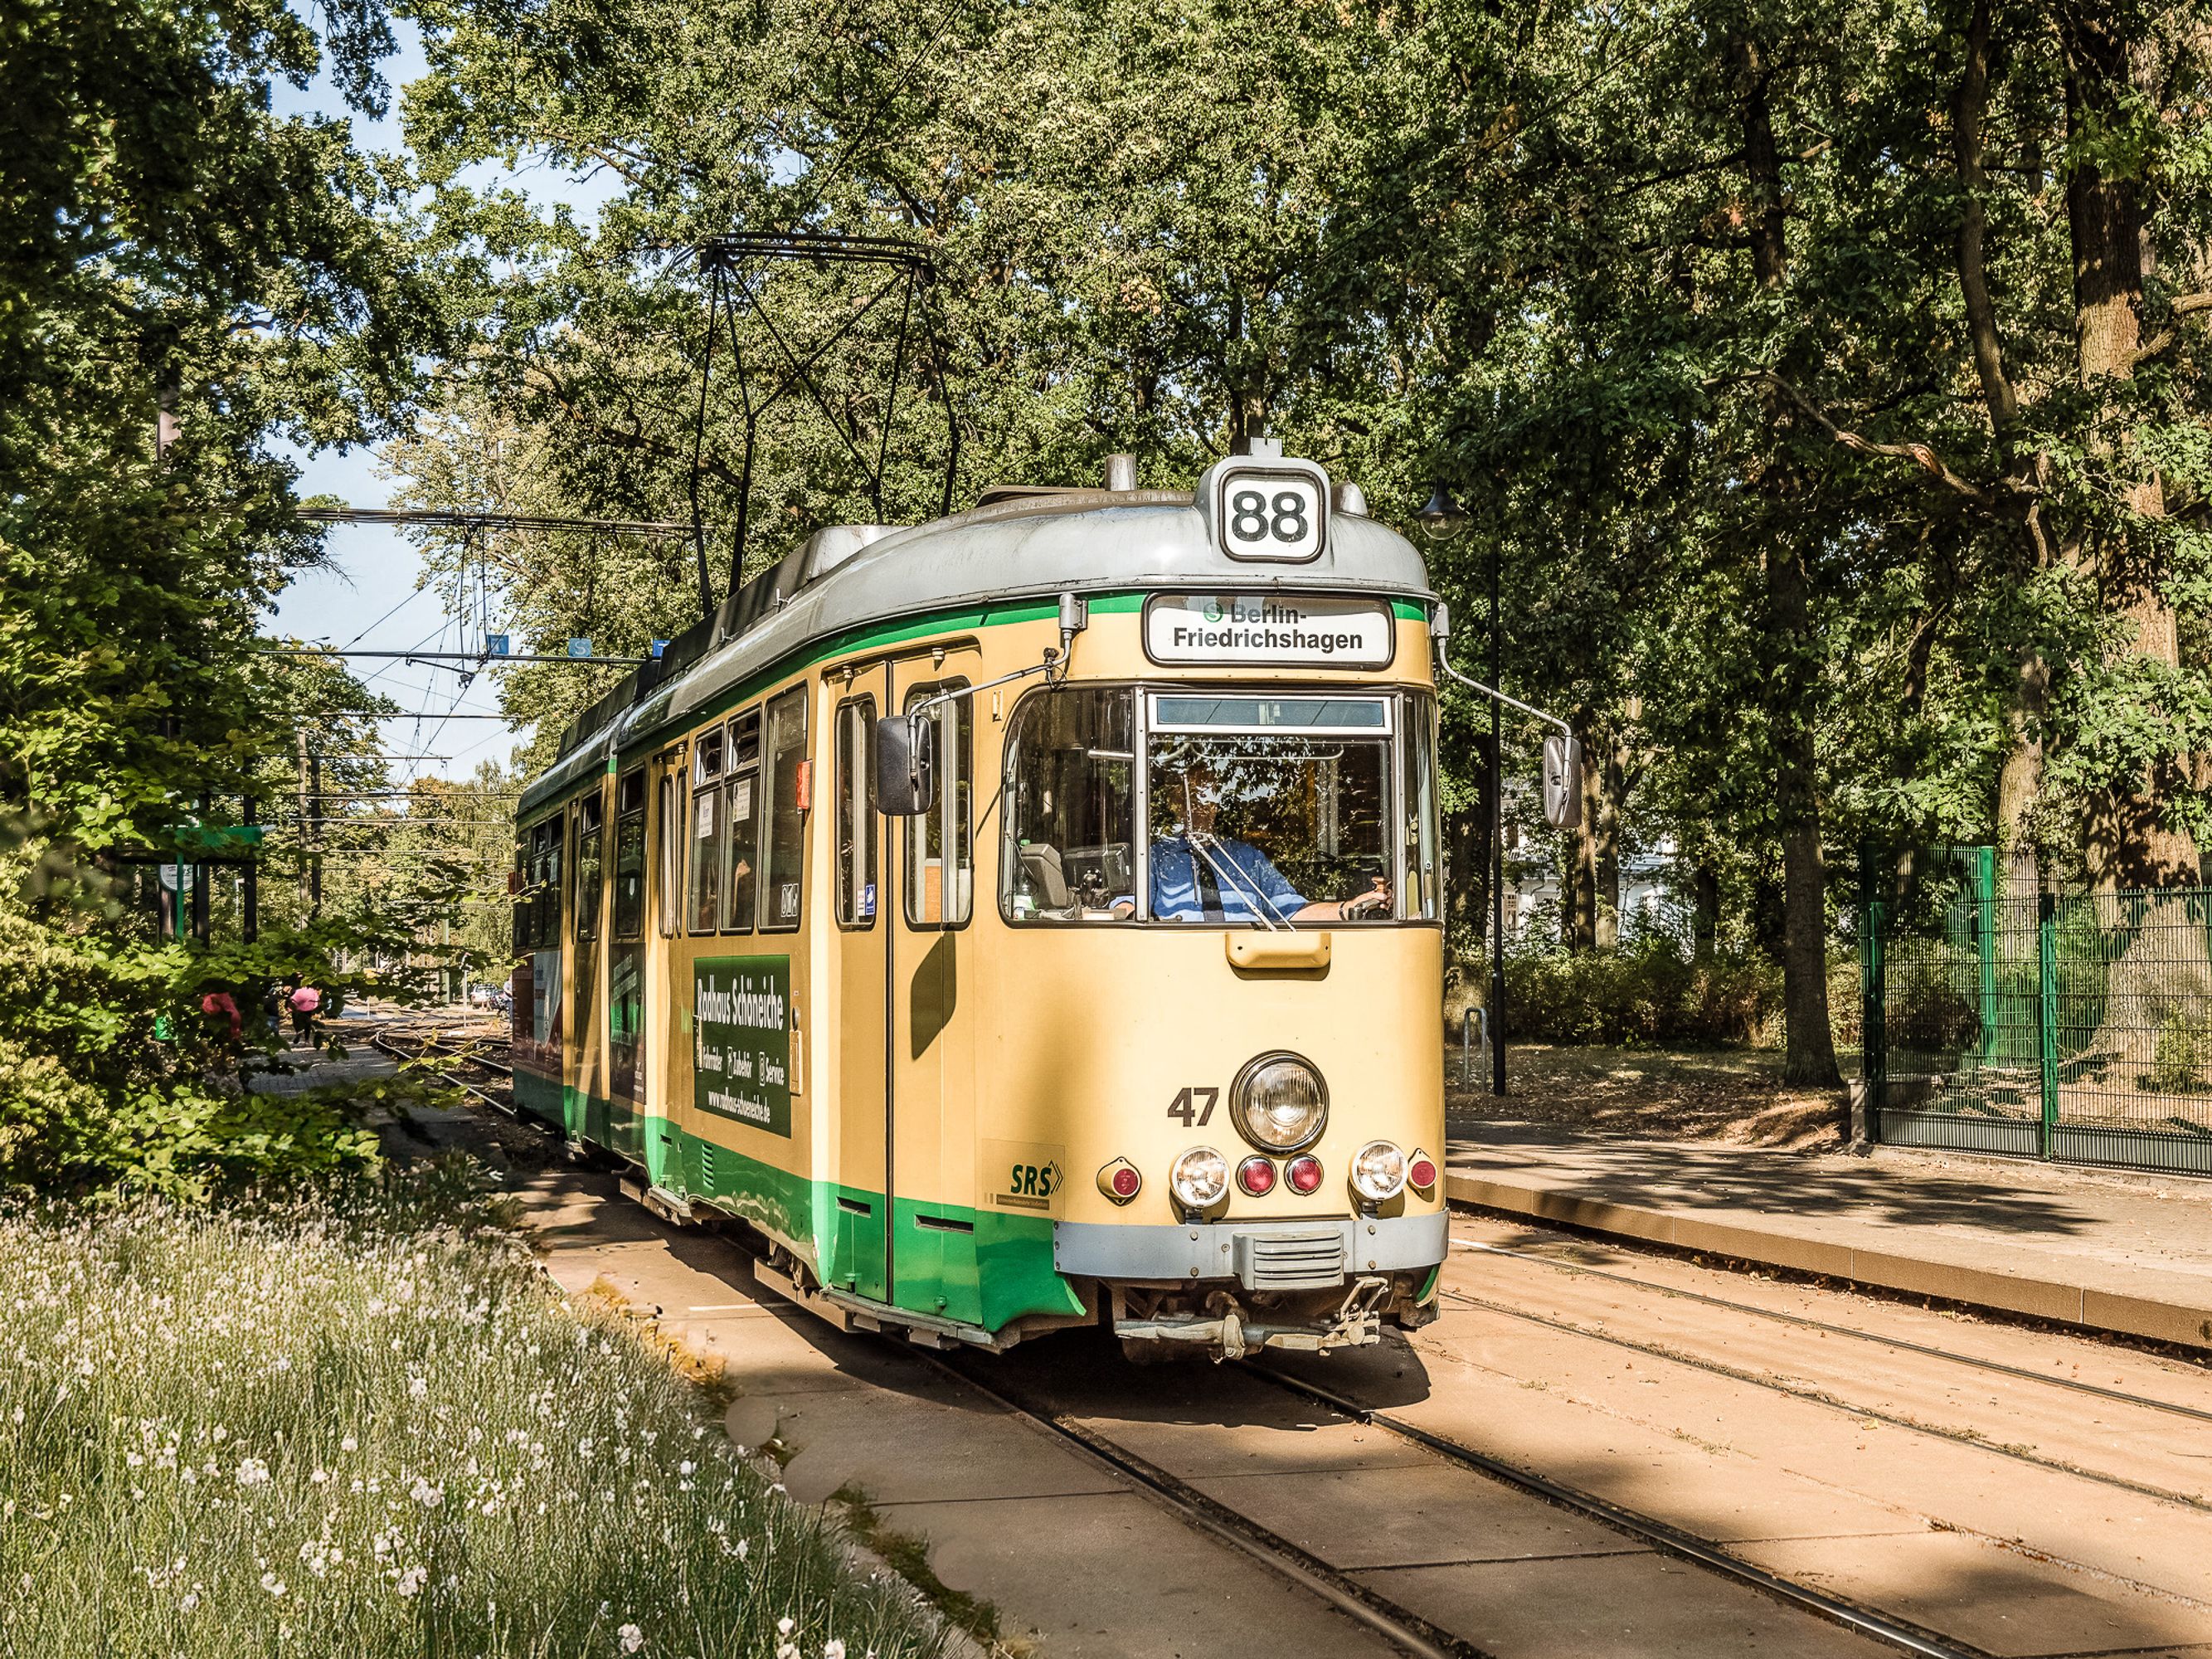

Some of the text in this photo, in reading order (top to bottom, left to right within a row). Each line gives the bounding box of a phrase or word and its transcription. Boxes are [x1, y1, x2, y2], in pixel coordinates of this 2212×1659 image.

[1232, 490, 1308, 542] 88
[1231, 604, 1306, 624] Berlin-
[1174, 628, 1363, 653] Friedrichshagen
[698, 975, 731, 1024] Radhaus
[732, 975, 784, 1030] Schöneiche
[766, 1056, 785, 1086] Service
[1167, 1087, 1219, 1127] 47
[1010, 1165, 1053, 1196] SRS
